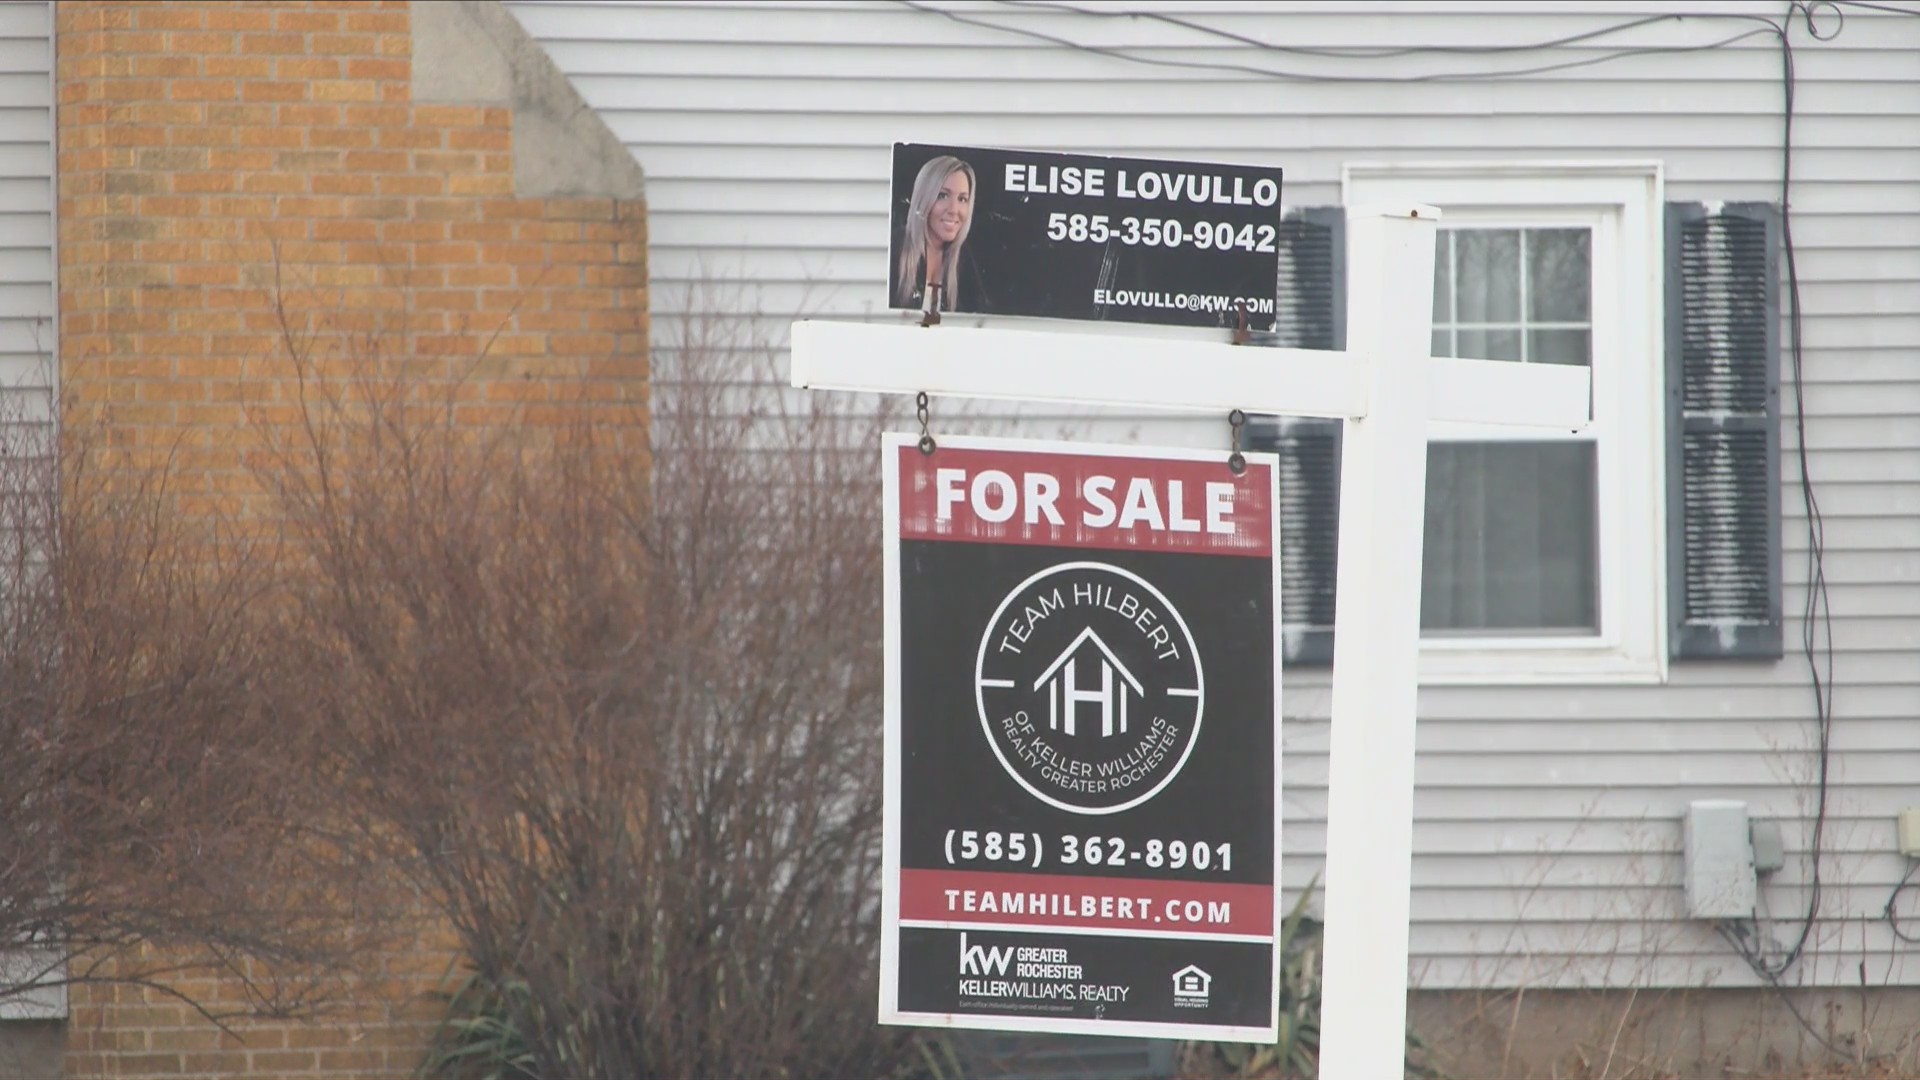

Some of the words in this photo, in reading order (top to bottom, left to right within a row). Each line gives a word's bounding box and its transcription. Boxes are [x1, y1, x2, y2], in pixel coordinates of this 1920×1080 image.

[1005, 164, 1104, 196] ELISE
[1117, 170, 1278, 206] LOVULLO
[1047, 213, 1276, 253] 585-350-9042
[936, 468, 1065, 526] FOR
[1083, 475, 1236, 534] SALE
[1000, 588, 1065, 654] TEAM
[1074, 583, 1180, 660] HILBERT
[1002, 718, 1042, 769] REALTY
[1041, 767, 1107, 793] GREATER
[1111, 725, 1180, 791] ROCHESTER
[1015, 710, 1036, 736] OF
[1031, 737, 1092, 778] KELLER
[1097, 716, 1167, 778] WILLIAMS
[944, 830, 1043, 868] (585)
[1061, 835, 1231, 871] 362-8901
[945, 889, 1231, 923] TEAMHILBERT.COM
[959, 932, 1014, 976] kw
[1016, 947, 1068, 963] GREATER
[1016, 962, 1082, 980] ROCHESTER
[1079, 985, 1130, 1002] REALTY
